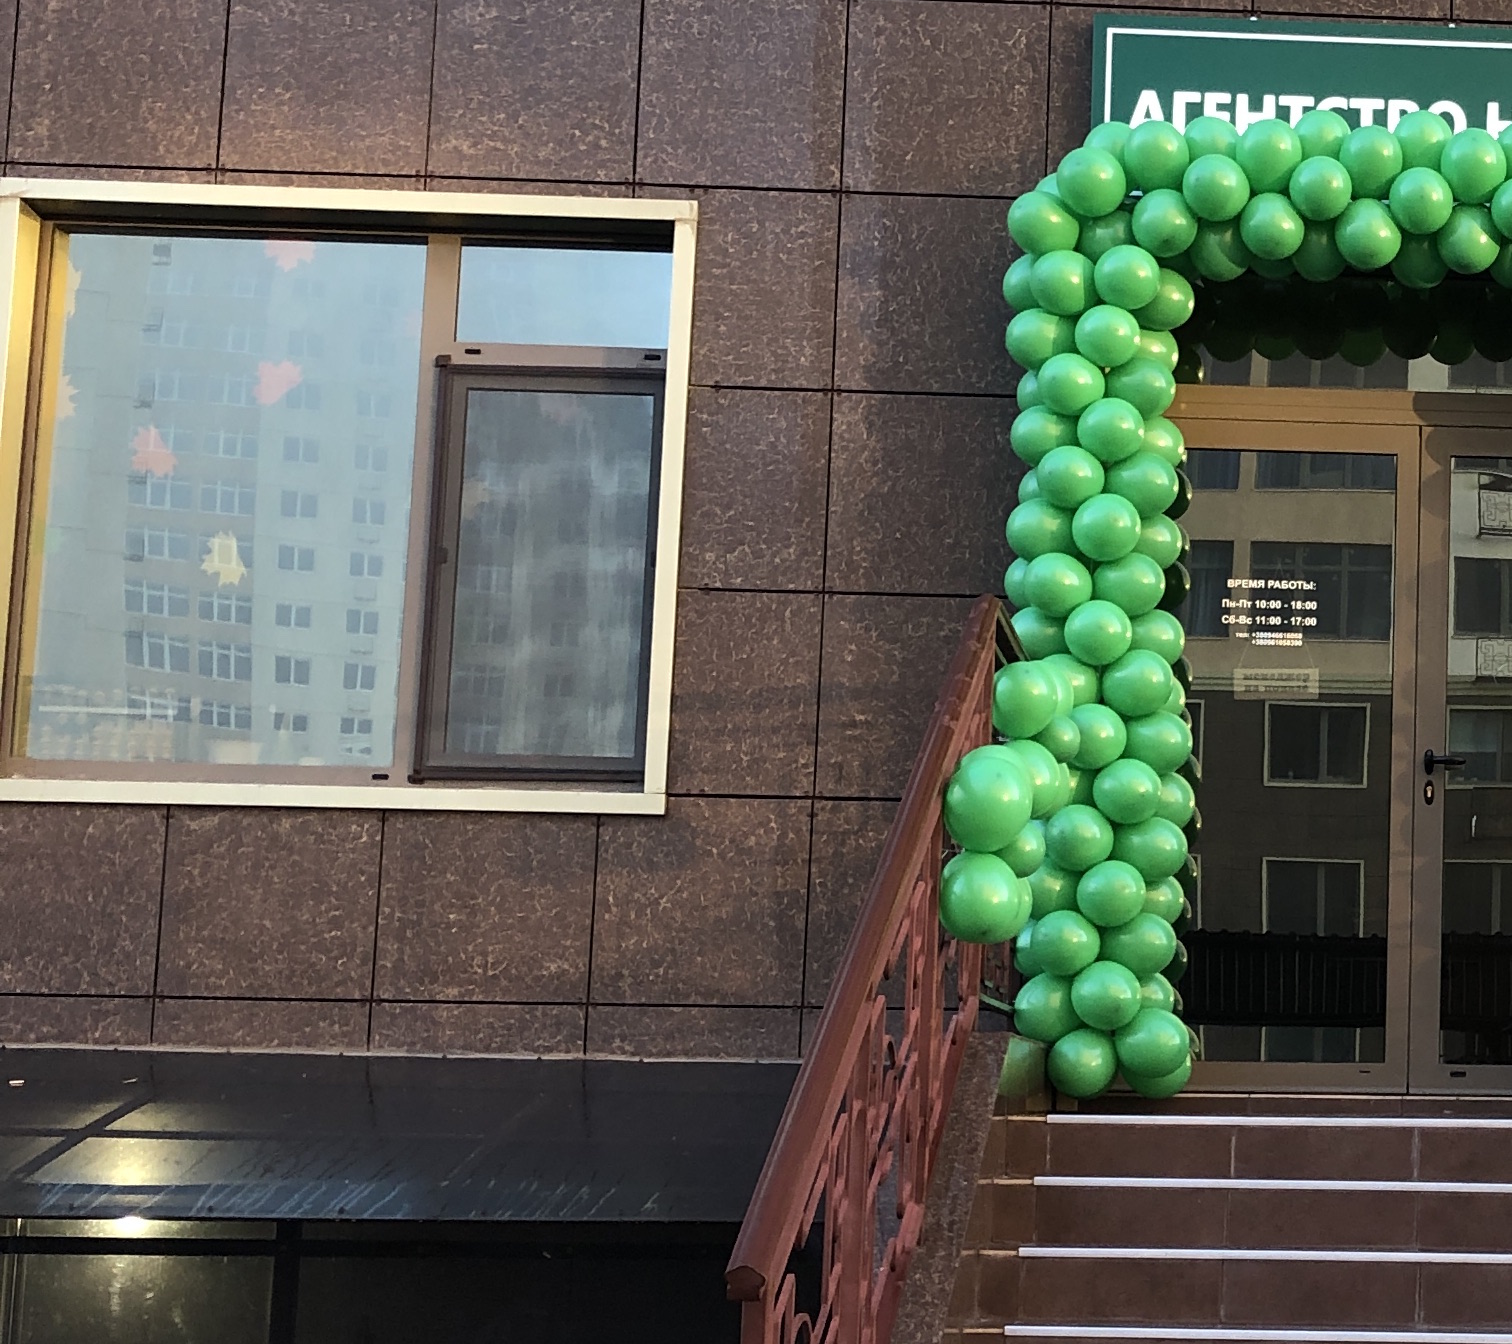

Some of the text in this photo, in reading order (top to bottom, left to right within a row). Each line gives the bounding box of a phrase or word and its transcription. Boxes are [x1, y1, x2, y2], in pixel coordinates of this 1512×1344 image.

[1226, 578, 1317, 591] ВРЕМЯ РАБОТЫ:
[1221, 598, 1253, 609] Пн-Пт
[1254, 599, 1282, 610] 10:00
[1290, 600, 1318, 611] 18:00
[1221, 615, 1253, 625] Сб-Вс
[1254, 615, 1282, 626] 11:00
[1290, 616, 1317, 627] 17:00
